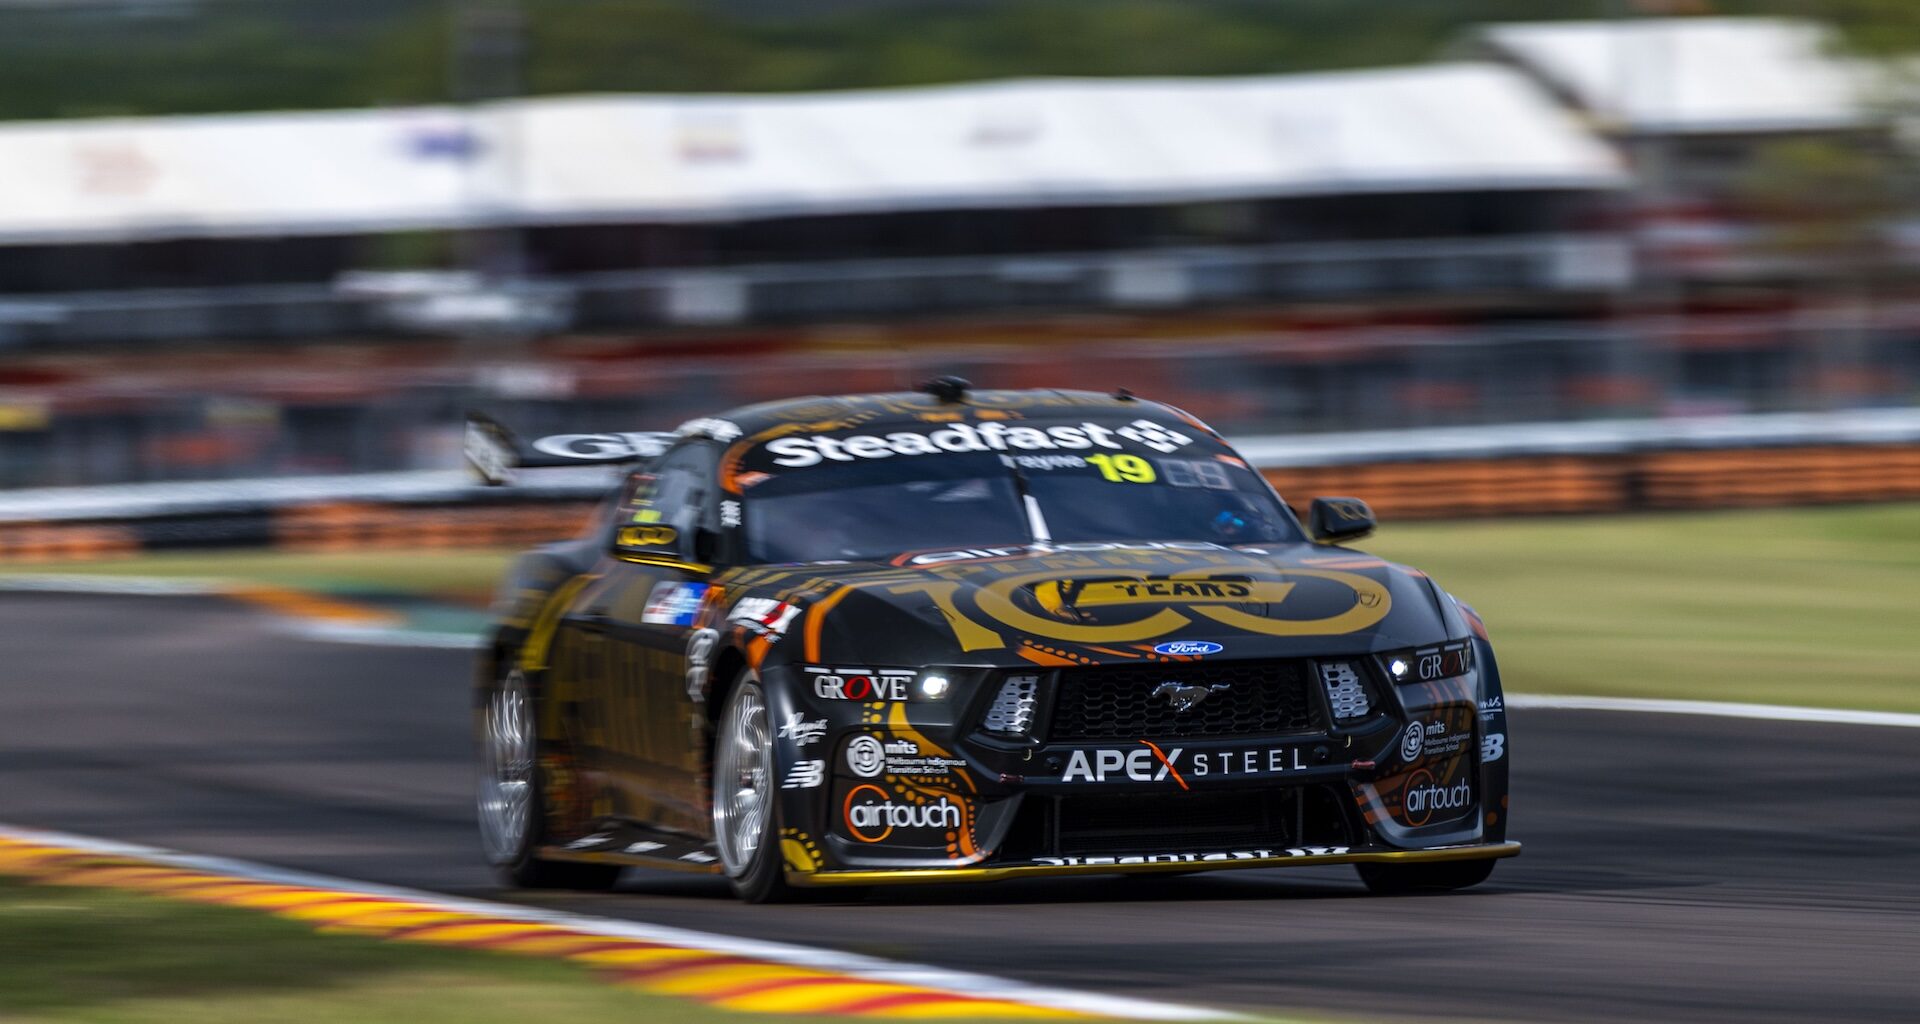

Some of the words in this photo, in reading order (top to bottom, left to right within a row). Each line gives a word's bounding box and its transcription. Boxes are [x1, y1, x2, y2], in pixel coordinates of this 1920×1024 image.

[765, 421, 1123, 468] Steadfast
[1084, 453, 1156, 483] 19
[1113, 582, 1250, 597] YEARS
[814, 675, 909, 700] GROVE
[1425, 721, 1445, 735] mits
[885, 740, 918, 754] mits
[1061, 743, 1188, 788] APEX
[1193, 748, 1307, 776] STEEL
[1406, 777, 1470, 812] airtouch
[850, 797, 960, 827] airtouch
